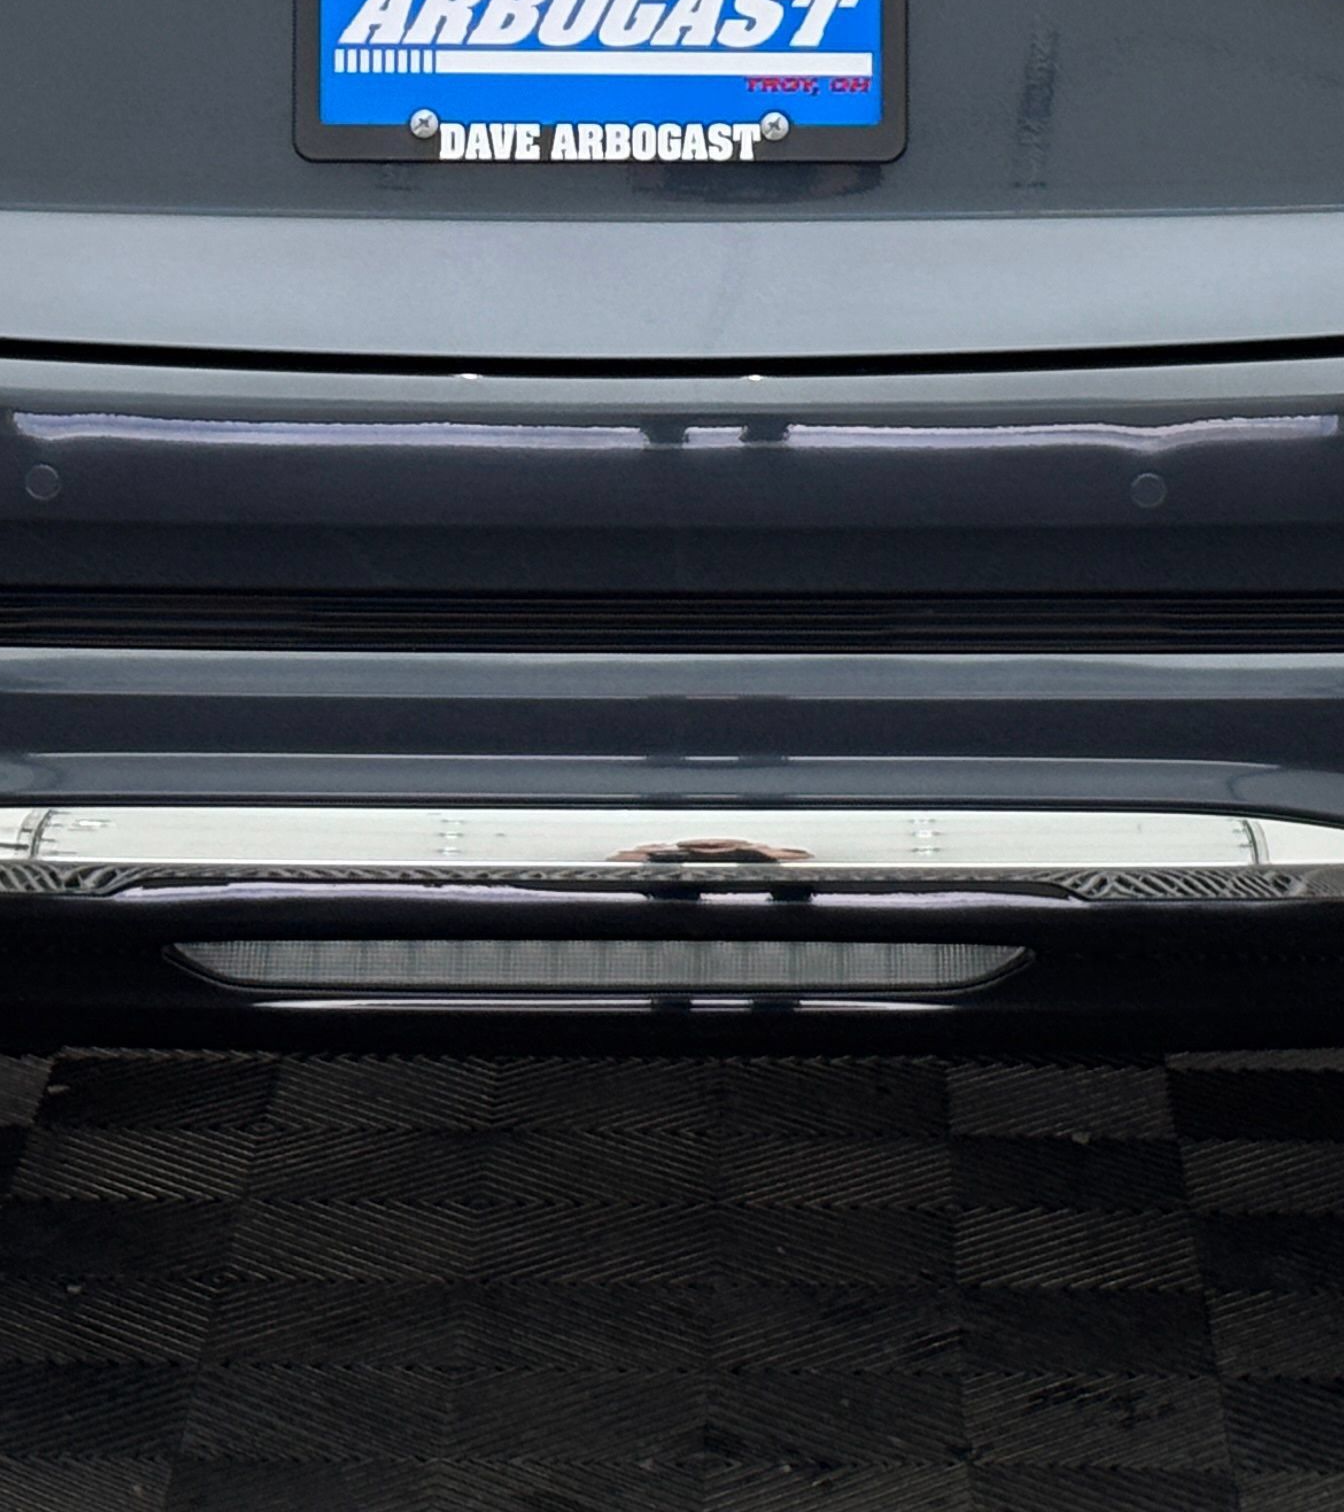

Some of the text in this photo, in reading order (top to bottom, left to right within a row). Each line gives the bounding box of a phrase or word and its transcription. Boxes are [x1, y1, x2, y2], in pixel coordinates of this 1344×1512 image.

[830, 77, 872, 93] OH
[439, 123, 762, 162] DAVE ARBOGAST
